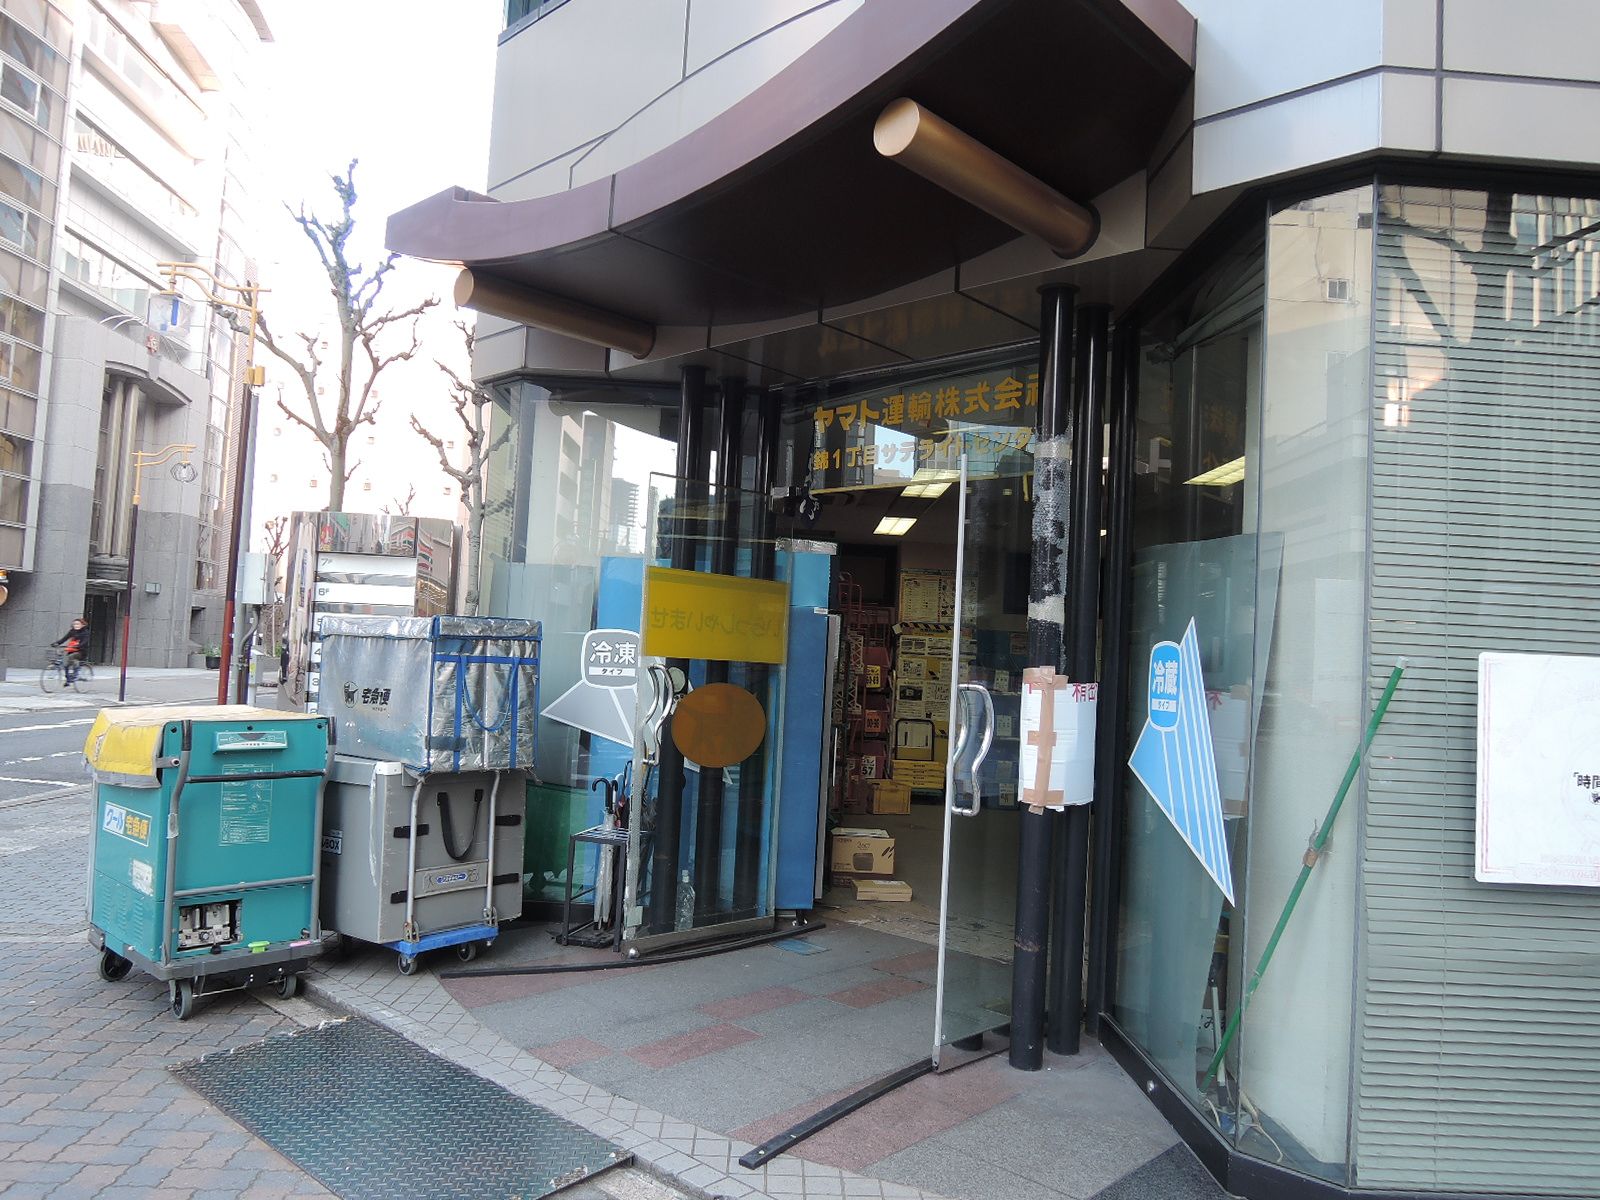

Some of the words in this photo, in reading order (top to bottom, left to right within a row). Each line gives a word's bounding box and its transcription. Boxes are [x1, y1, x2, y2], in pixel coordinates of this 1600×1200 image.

[589, 640, 637, 665] 冷凍
[1152, 660, 1178, 695] 冷蔵
[361, 687, 391, 705] 宅急便
